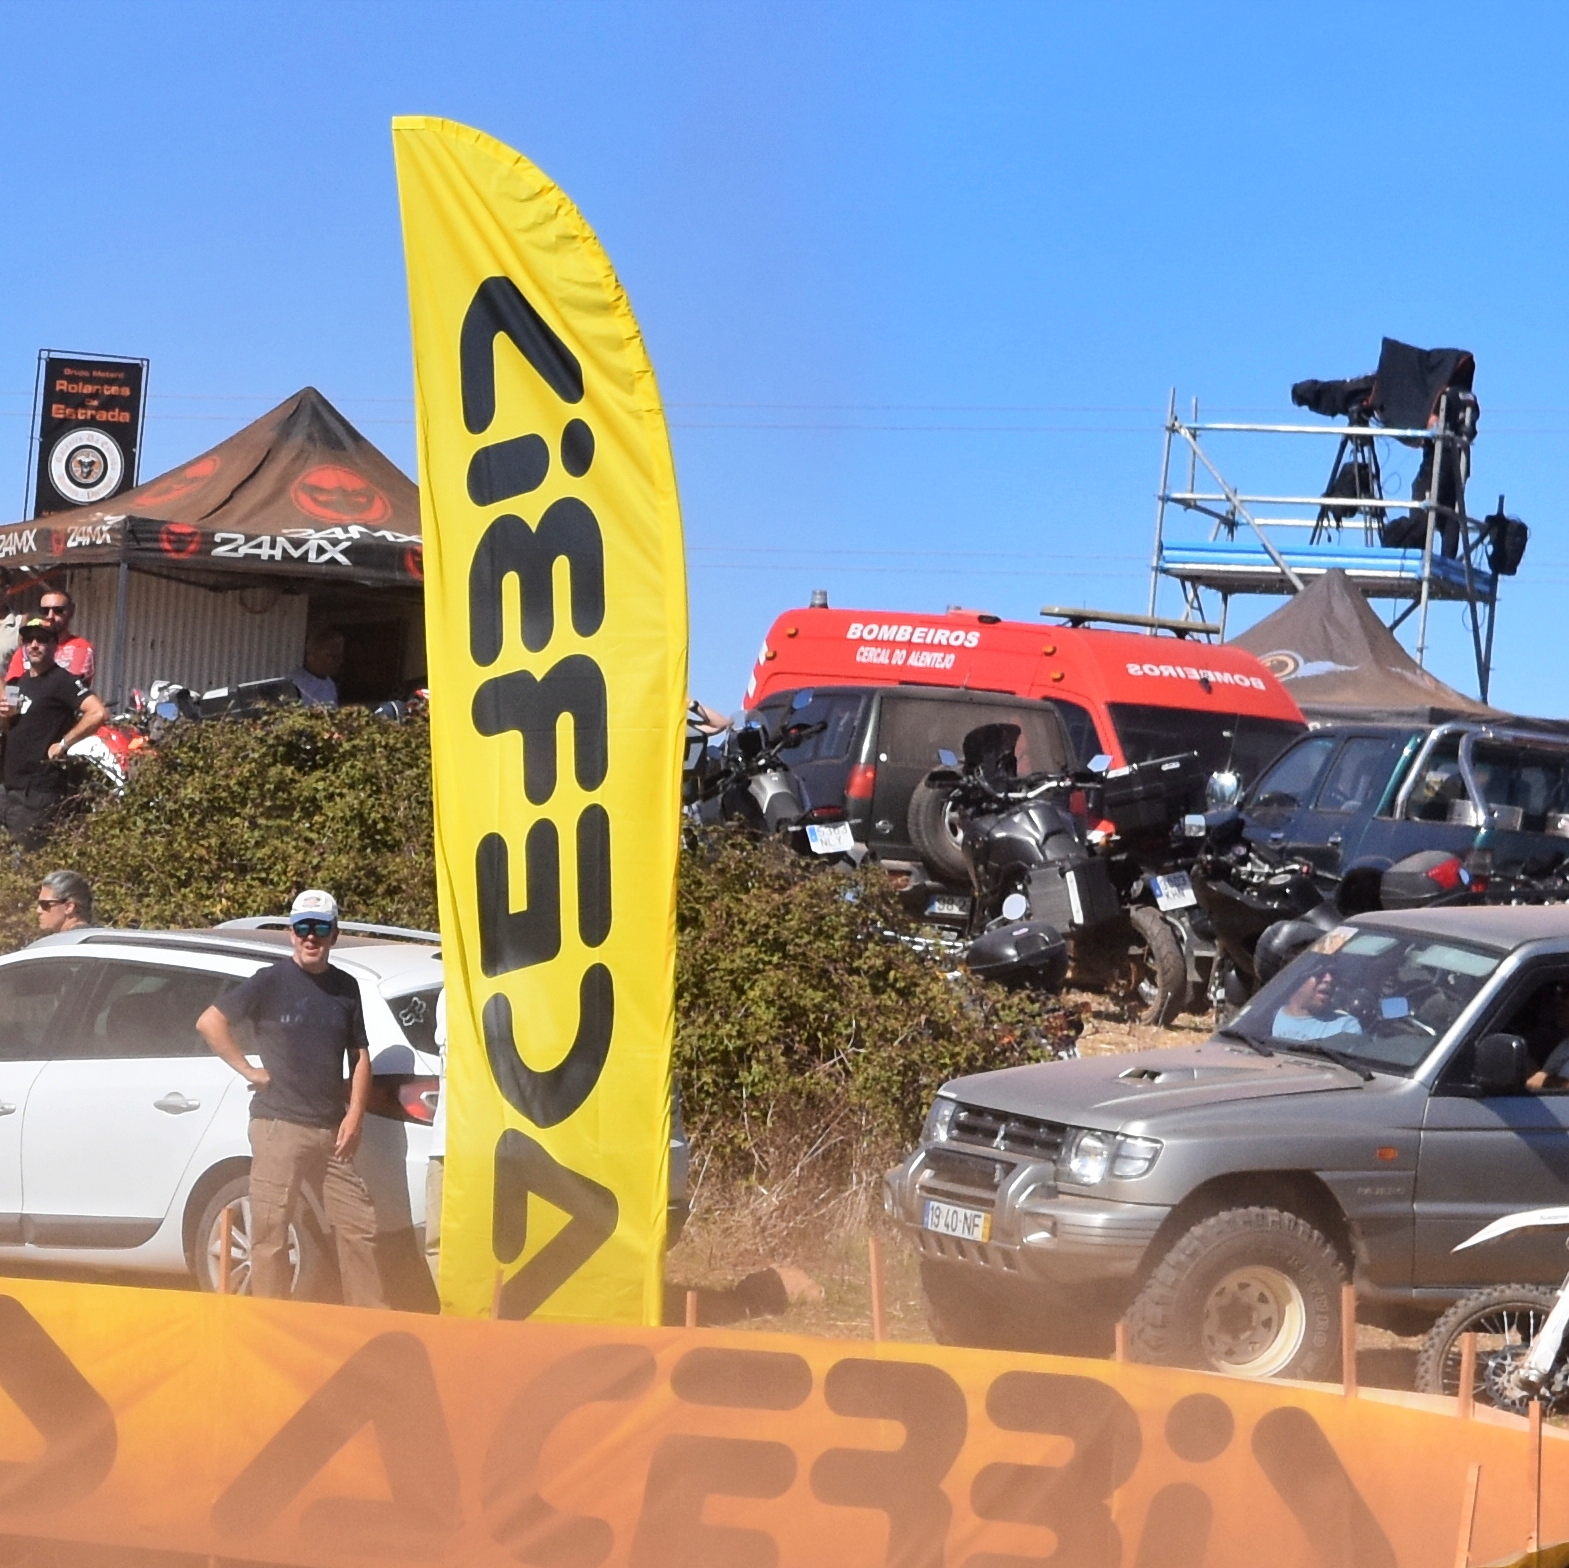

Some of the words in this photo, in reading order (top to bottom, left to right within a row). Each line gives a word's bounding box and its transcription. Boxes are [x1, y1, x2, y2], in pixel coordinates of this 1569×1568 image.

[51, 403, 130, 423] Estrada
[211, 532, 351, 566] 24MX
[846, 623, 980, 648] BOMBEIROS
[855, 646, 889, 666] CERCAL
[891, 650, 905, 667] DO
[908, 651, 955, 669] ALENTEJO
